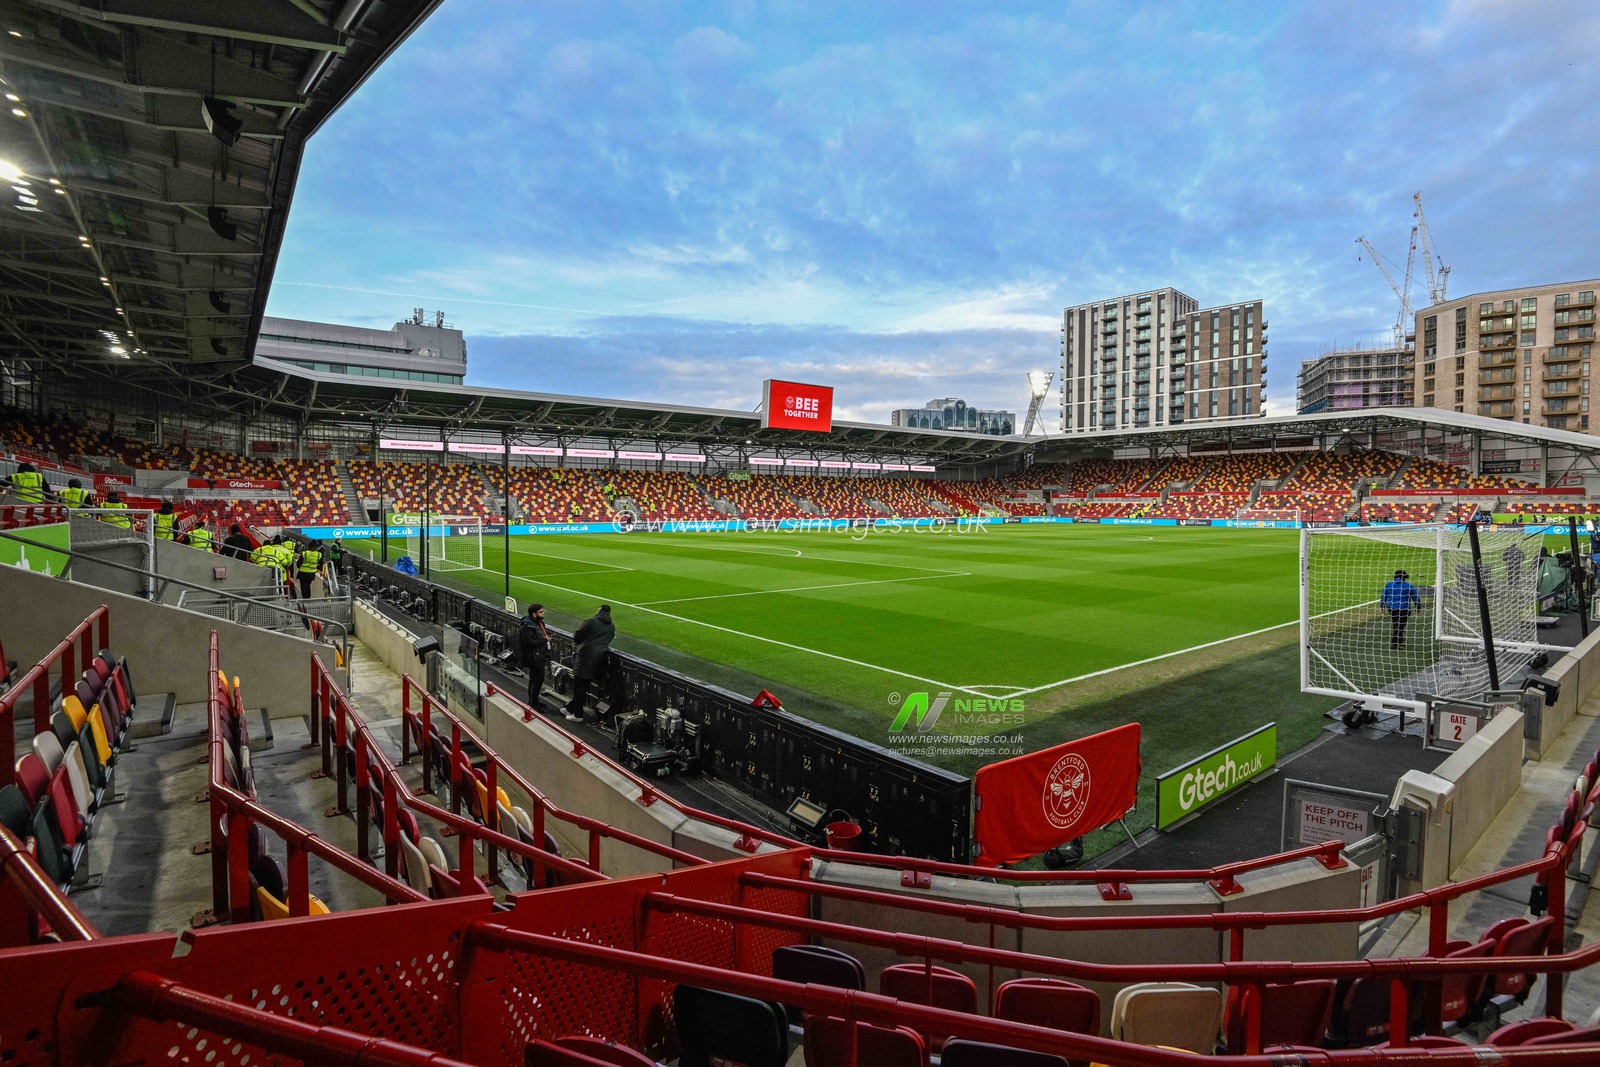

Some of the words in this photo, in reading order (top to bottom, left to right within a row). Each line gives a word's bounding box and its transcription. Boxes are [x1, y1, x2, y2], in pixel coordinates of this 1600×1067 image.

[796, 396, 818, 411] BEE
[784, 409, 818, 419] TOGETHER
[346, 528, 412, 536] www.uw.ac.uk
[1450, 715, 1467, 725] GATE
[1454, 725, 1462, 740] 2
[1050, 757, 1084, 780] BRENTFORD
[1179, 751, 1262, 810] Gtech.co.uk
[1050, 812, 1073, 825] FOOTBALL
[1073, 800, 1084, 817] CLUB
[1305, 804, 1334, 815] KEEP
[1338, 810, 1359, 820] OFF
[1305, 814, 1326, 825] THE
[1330, 819, 1363, 831] PITCH
[1362, 865, 1372, 882] GATE
